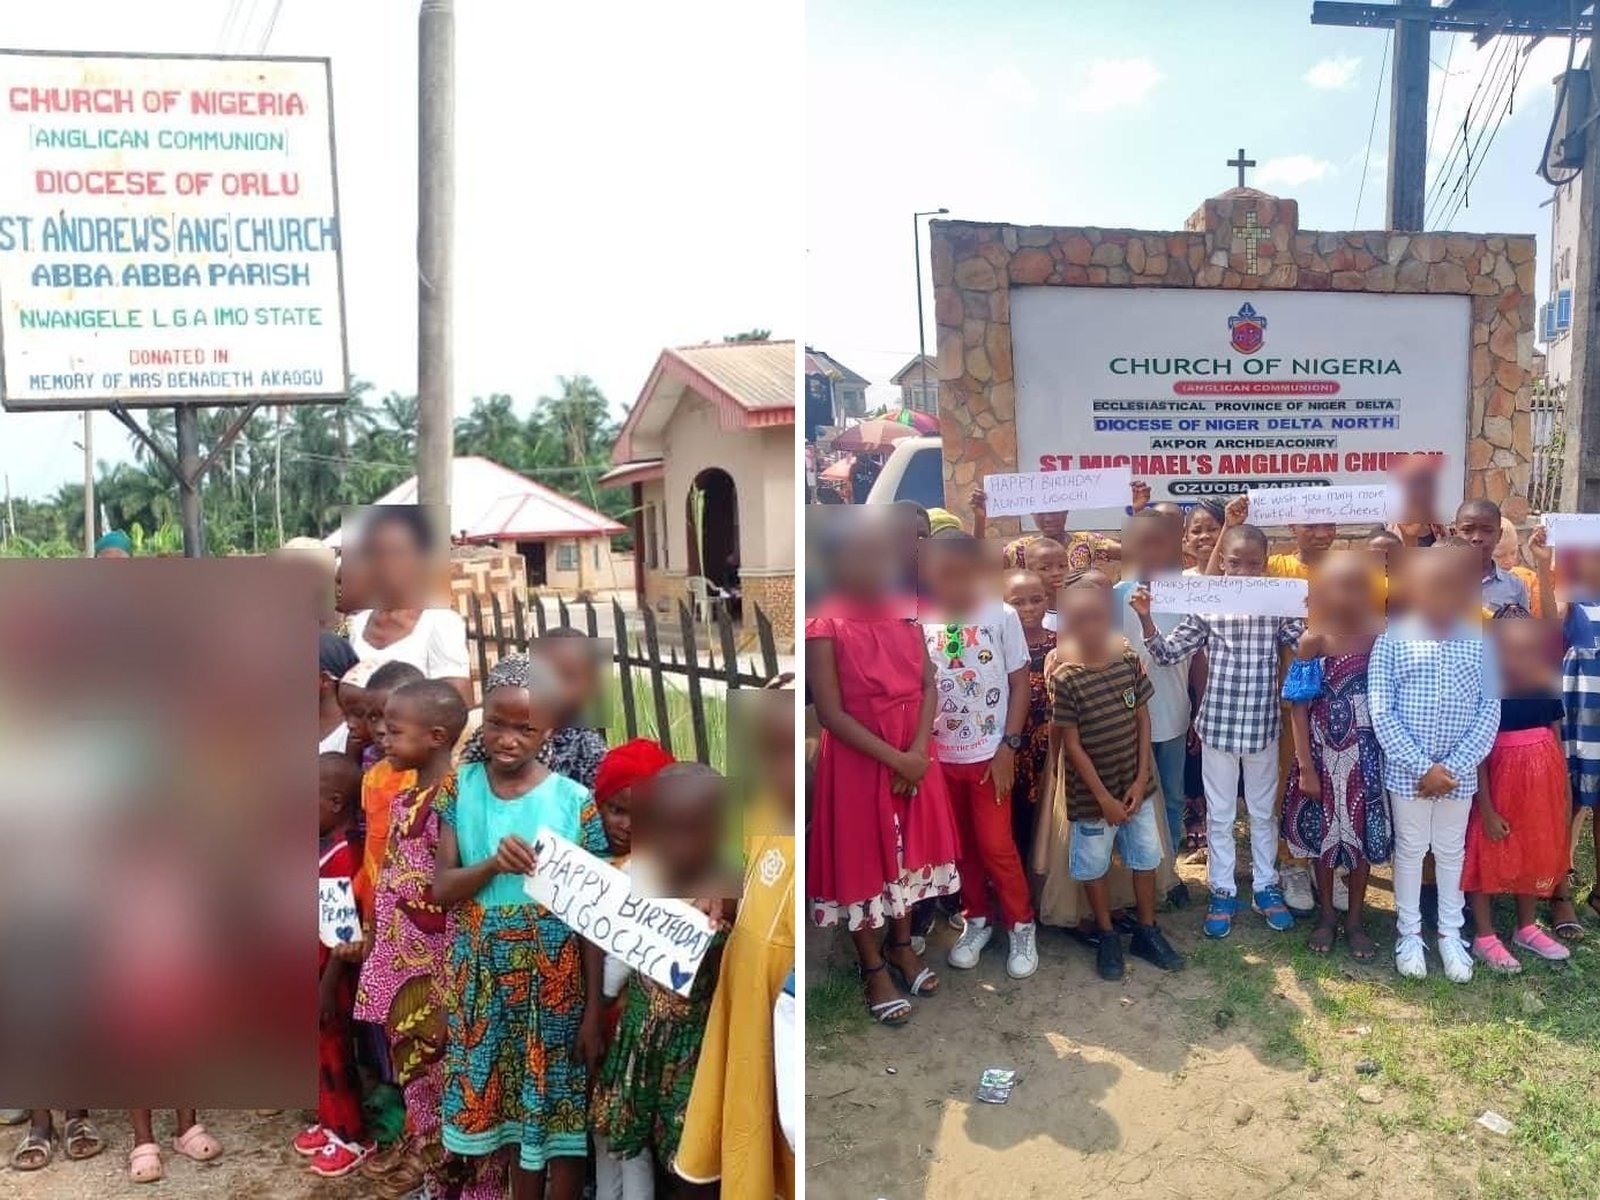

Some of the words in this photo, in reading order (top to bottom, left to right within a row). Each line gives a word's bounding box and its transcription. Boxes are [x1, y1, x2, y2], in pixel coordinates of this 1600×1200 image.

[9, 88, 133, 113] CHURCH
[142, 90, 180, 113] OF
[191, 92, 305, 116] NIGERIA
[35, 170, 165, 194] DIOCESE
[176, 173, 213, 195] OF
[222, 173, 299, 196] ORLU
[235, 218, 337, 252] CHURCH
[121, 264, 200, 287] ABBA
[208, 263, 310, 287] PARISH
[20, 309, 142, 328] NWANGELE
[214, 308, 248, 326] IMO
[255, 307, 322, 326] STATE
[129, 349, 205, 365] DONATED
[214, 349, 229, 364] IN
[1109, 358, 1232, 375] CHURCH
[1243, 358, 1282, 375] OF
[1292, 358, 1402, 375] NIGERIA
[30, 374, 94, 390] MEMORY
[102, 373, 123, 389] OF
[129, 373, 162, 389] MRS
[168, 372, 252, 388] BENADETH
[1093, 401, 1206, 411] ECCLESIASTICAL
[1215, 401, 1282, 411] PROVINCE
[1286, 401, 1303, 410] OF
[1308, 401, 1346, 410] NIGER
[1356, 400, 1394, 409] DELTA
[1095, 419, 1172, 431] DIOCESE
[1178, 419, 1201, 431] OF
[1205, 419, 1259, 431] NIGER
[1267, 418, 1323, 430] DELTA
[1331, 417, 1394, 429] NORTH
[1152, 439, 1207, 449] AKPOR
[1214, 438, 1335, 449] ARCHDEACONRY
[1040, 454, 1073, 472] ST
[1218, 452, 1338, 475] ANGLICAN
[989, 476, 1035, 492] HAPPY
[1041, 473, 1102, 490] BIRTHDAY
[1302, 493, 1322, 505] you
[1358, 489, 1385, 499] more
[538, 836, 610, 906] HAPPY
